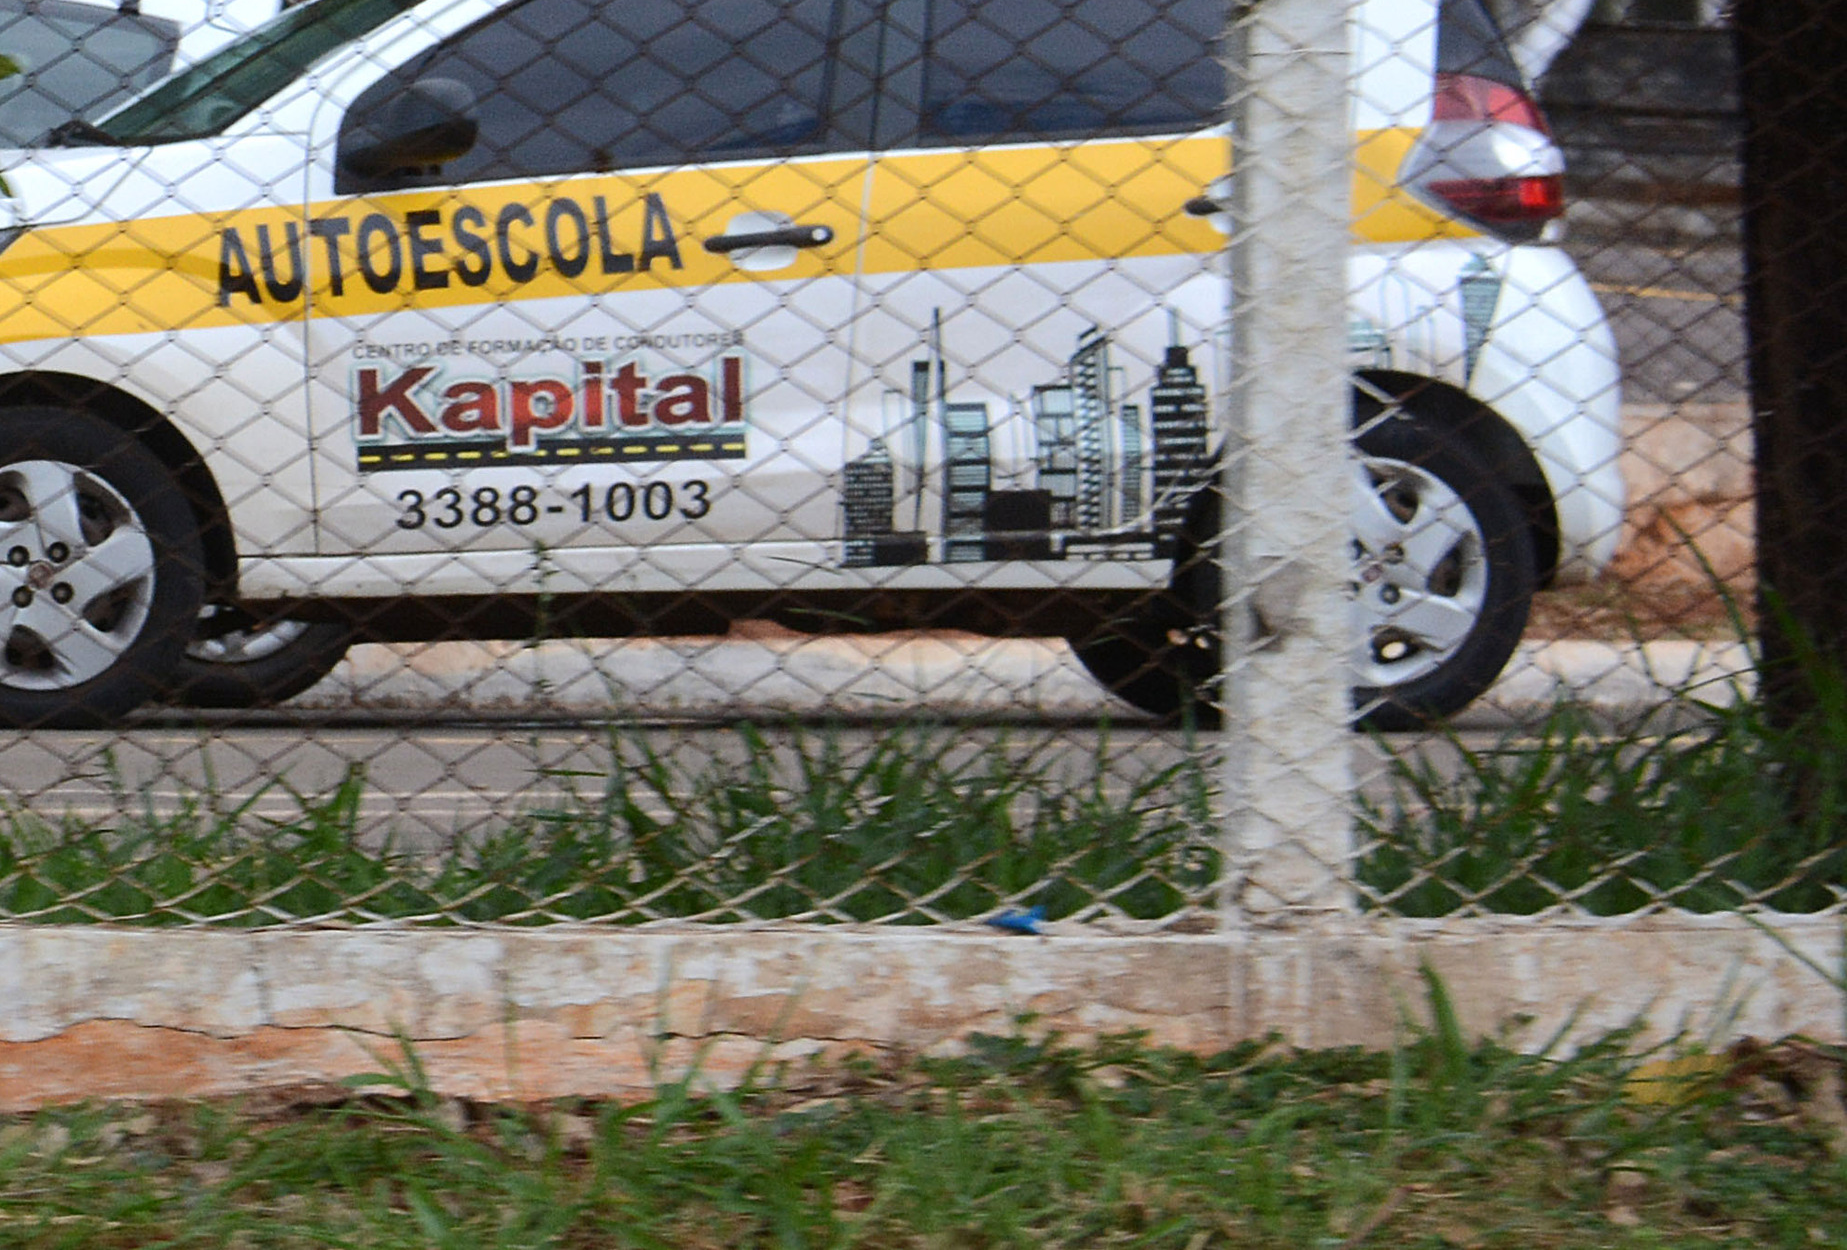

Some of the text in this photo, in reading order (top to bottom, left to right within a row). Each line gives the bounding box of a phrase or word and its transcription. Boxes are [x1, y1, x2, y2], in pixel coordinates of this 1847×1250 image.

[217, 192, 684, 308] AUTOESCOLA
[354, 341, 431, 359] CENTRO
[437, 340, 463, 356] DE
[583, 336, 609, 351] DE
[614, 330, 744, 350] CONDUTORES
[356, 354, 744, 447] Kapital
[396, 479, 711, 530] 3388-1003
